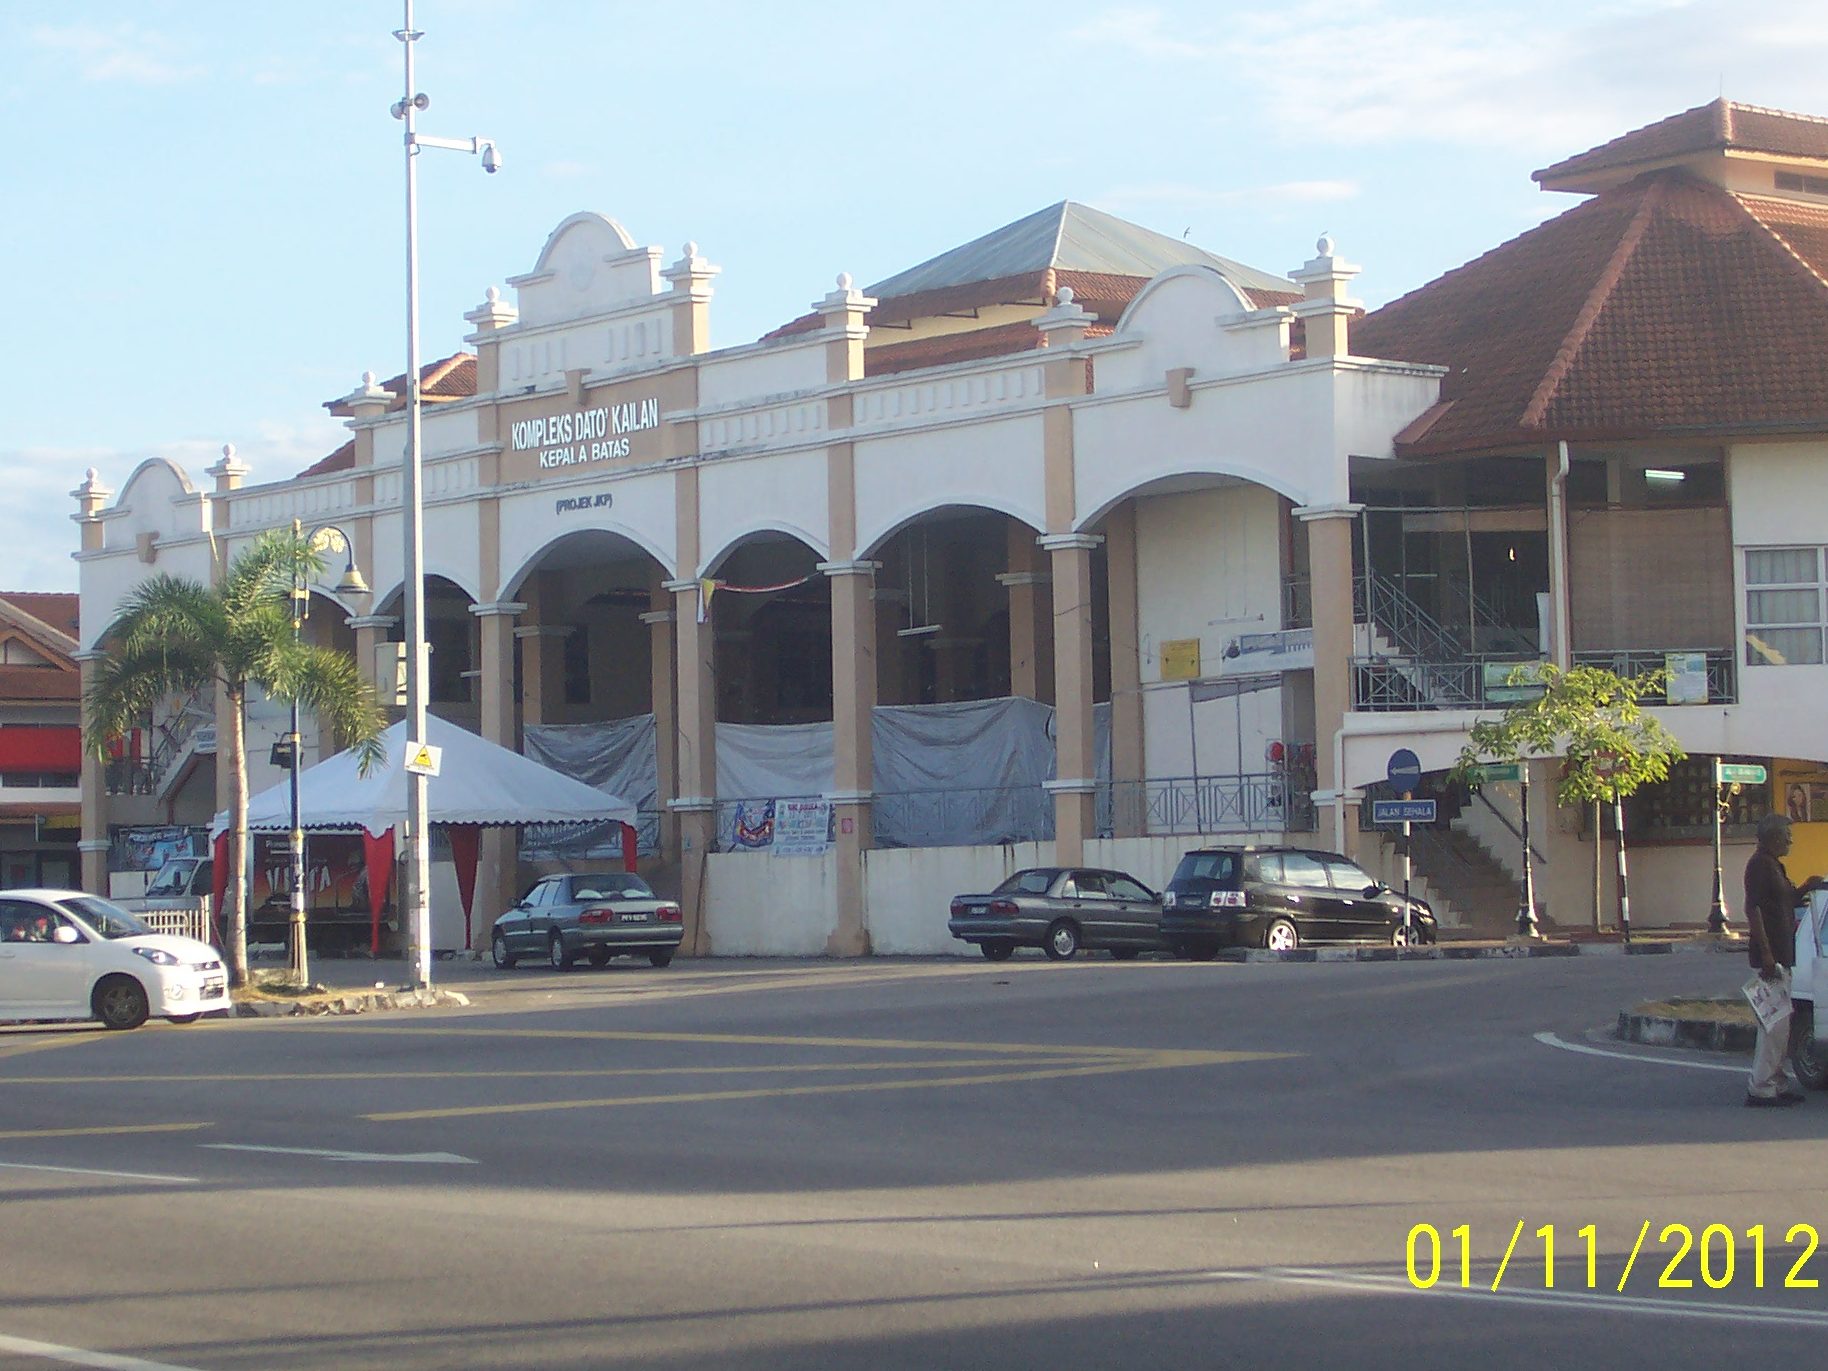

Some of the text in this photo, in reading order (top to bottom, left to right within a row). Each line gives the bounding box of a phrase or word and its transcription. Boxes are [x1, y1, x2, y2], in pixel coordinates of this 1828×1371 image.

[511, 398, 659, 450] KOMPLEKS DATO' KAILAN
[540, 438, 631, 469] KEPALA BATAS
[1377, 807, 1400, 817] JALAN
